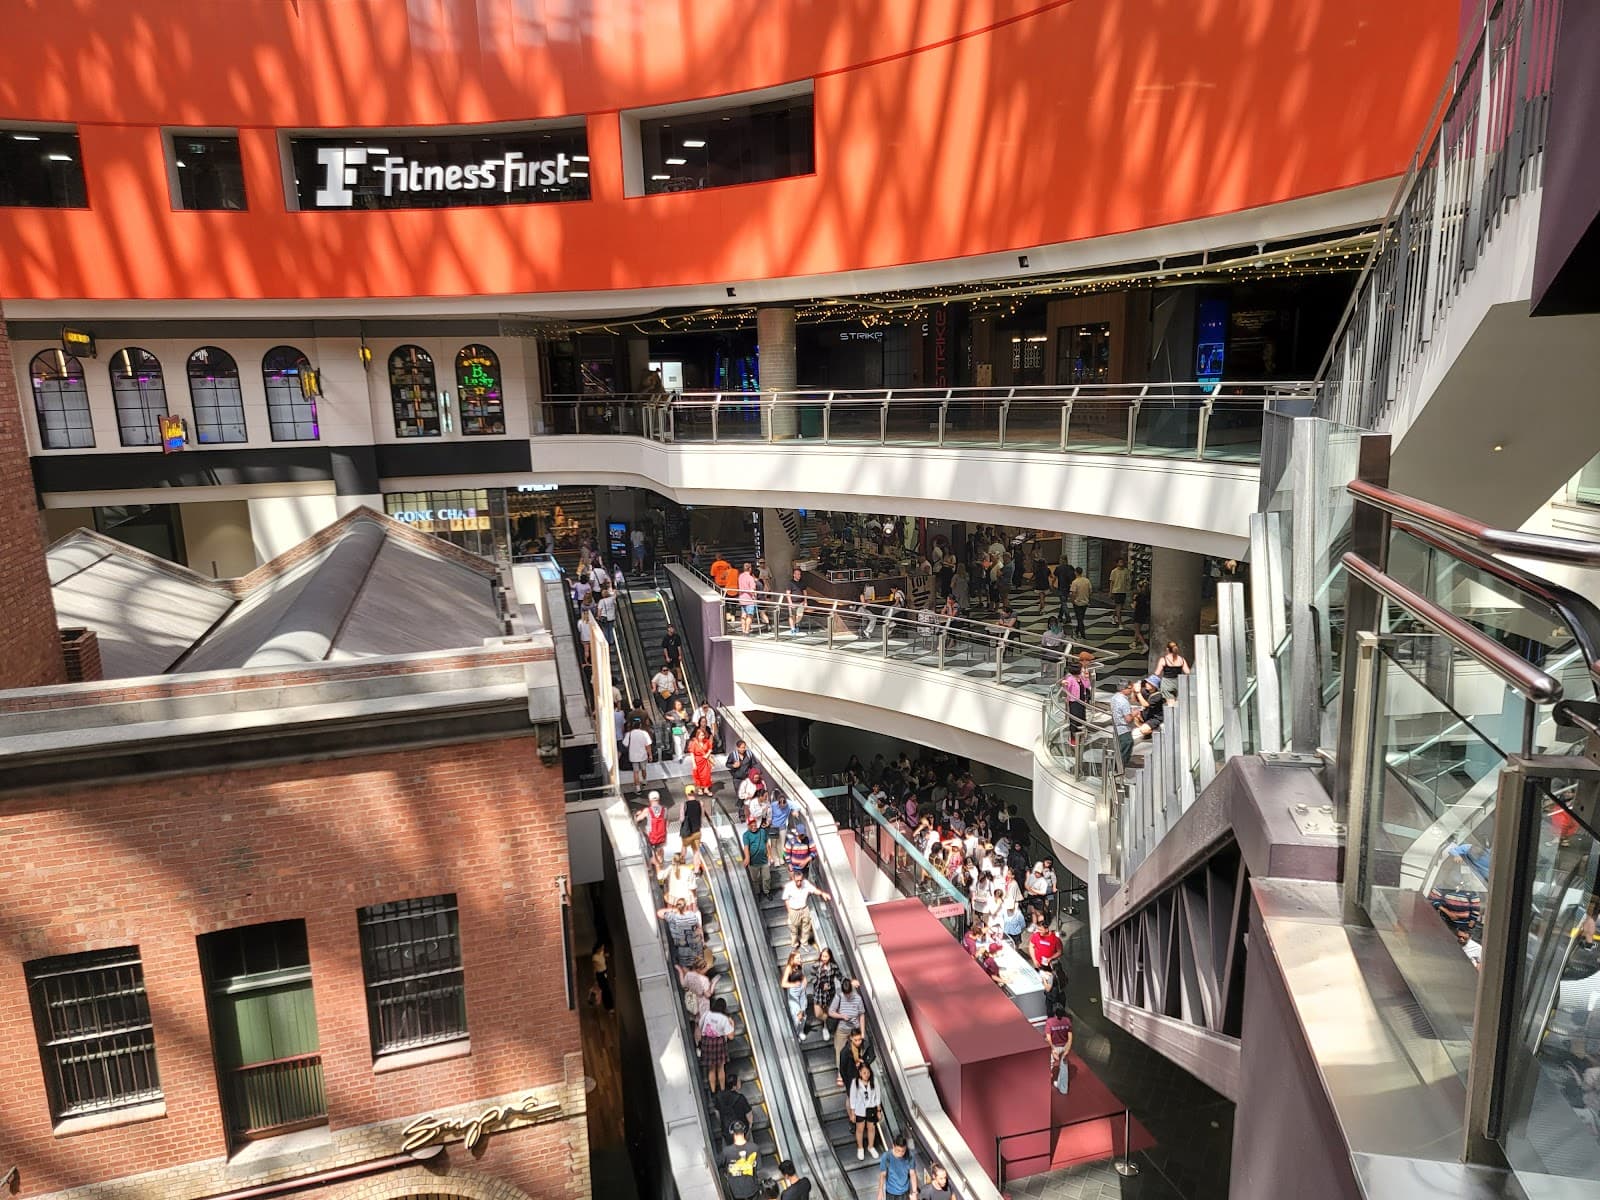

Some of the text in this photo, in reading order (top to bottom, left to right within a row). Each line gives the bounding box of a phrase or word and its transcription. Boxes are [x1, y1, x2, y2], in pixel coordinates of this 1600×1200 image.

[384, 156, 496, 197] Fitness
[503, 151, 569, 193] First
[935, 310, 947, 388] STRIKE
